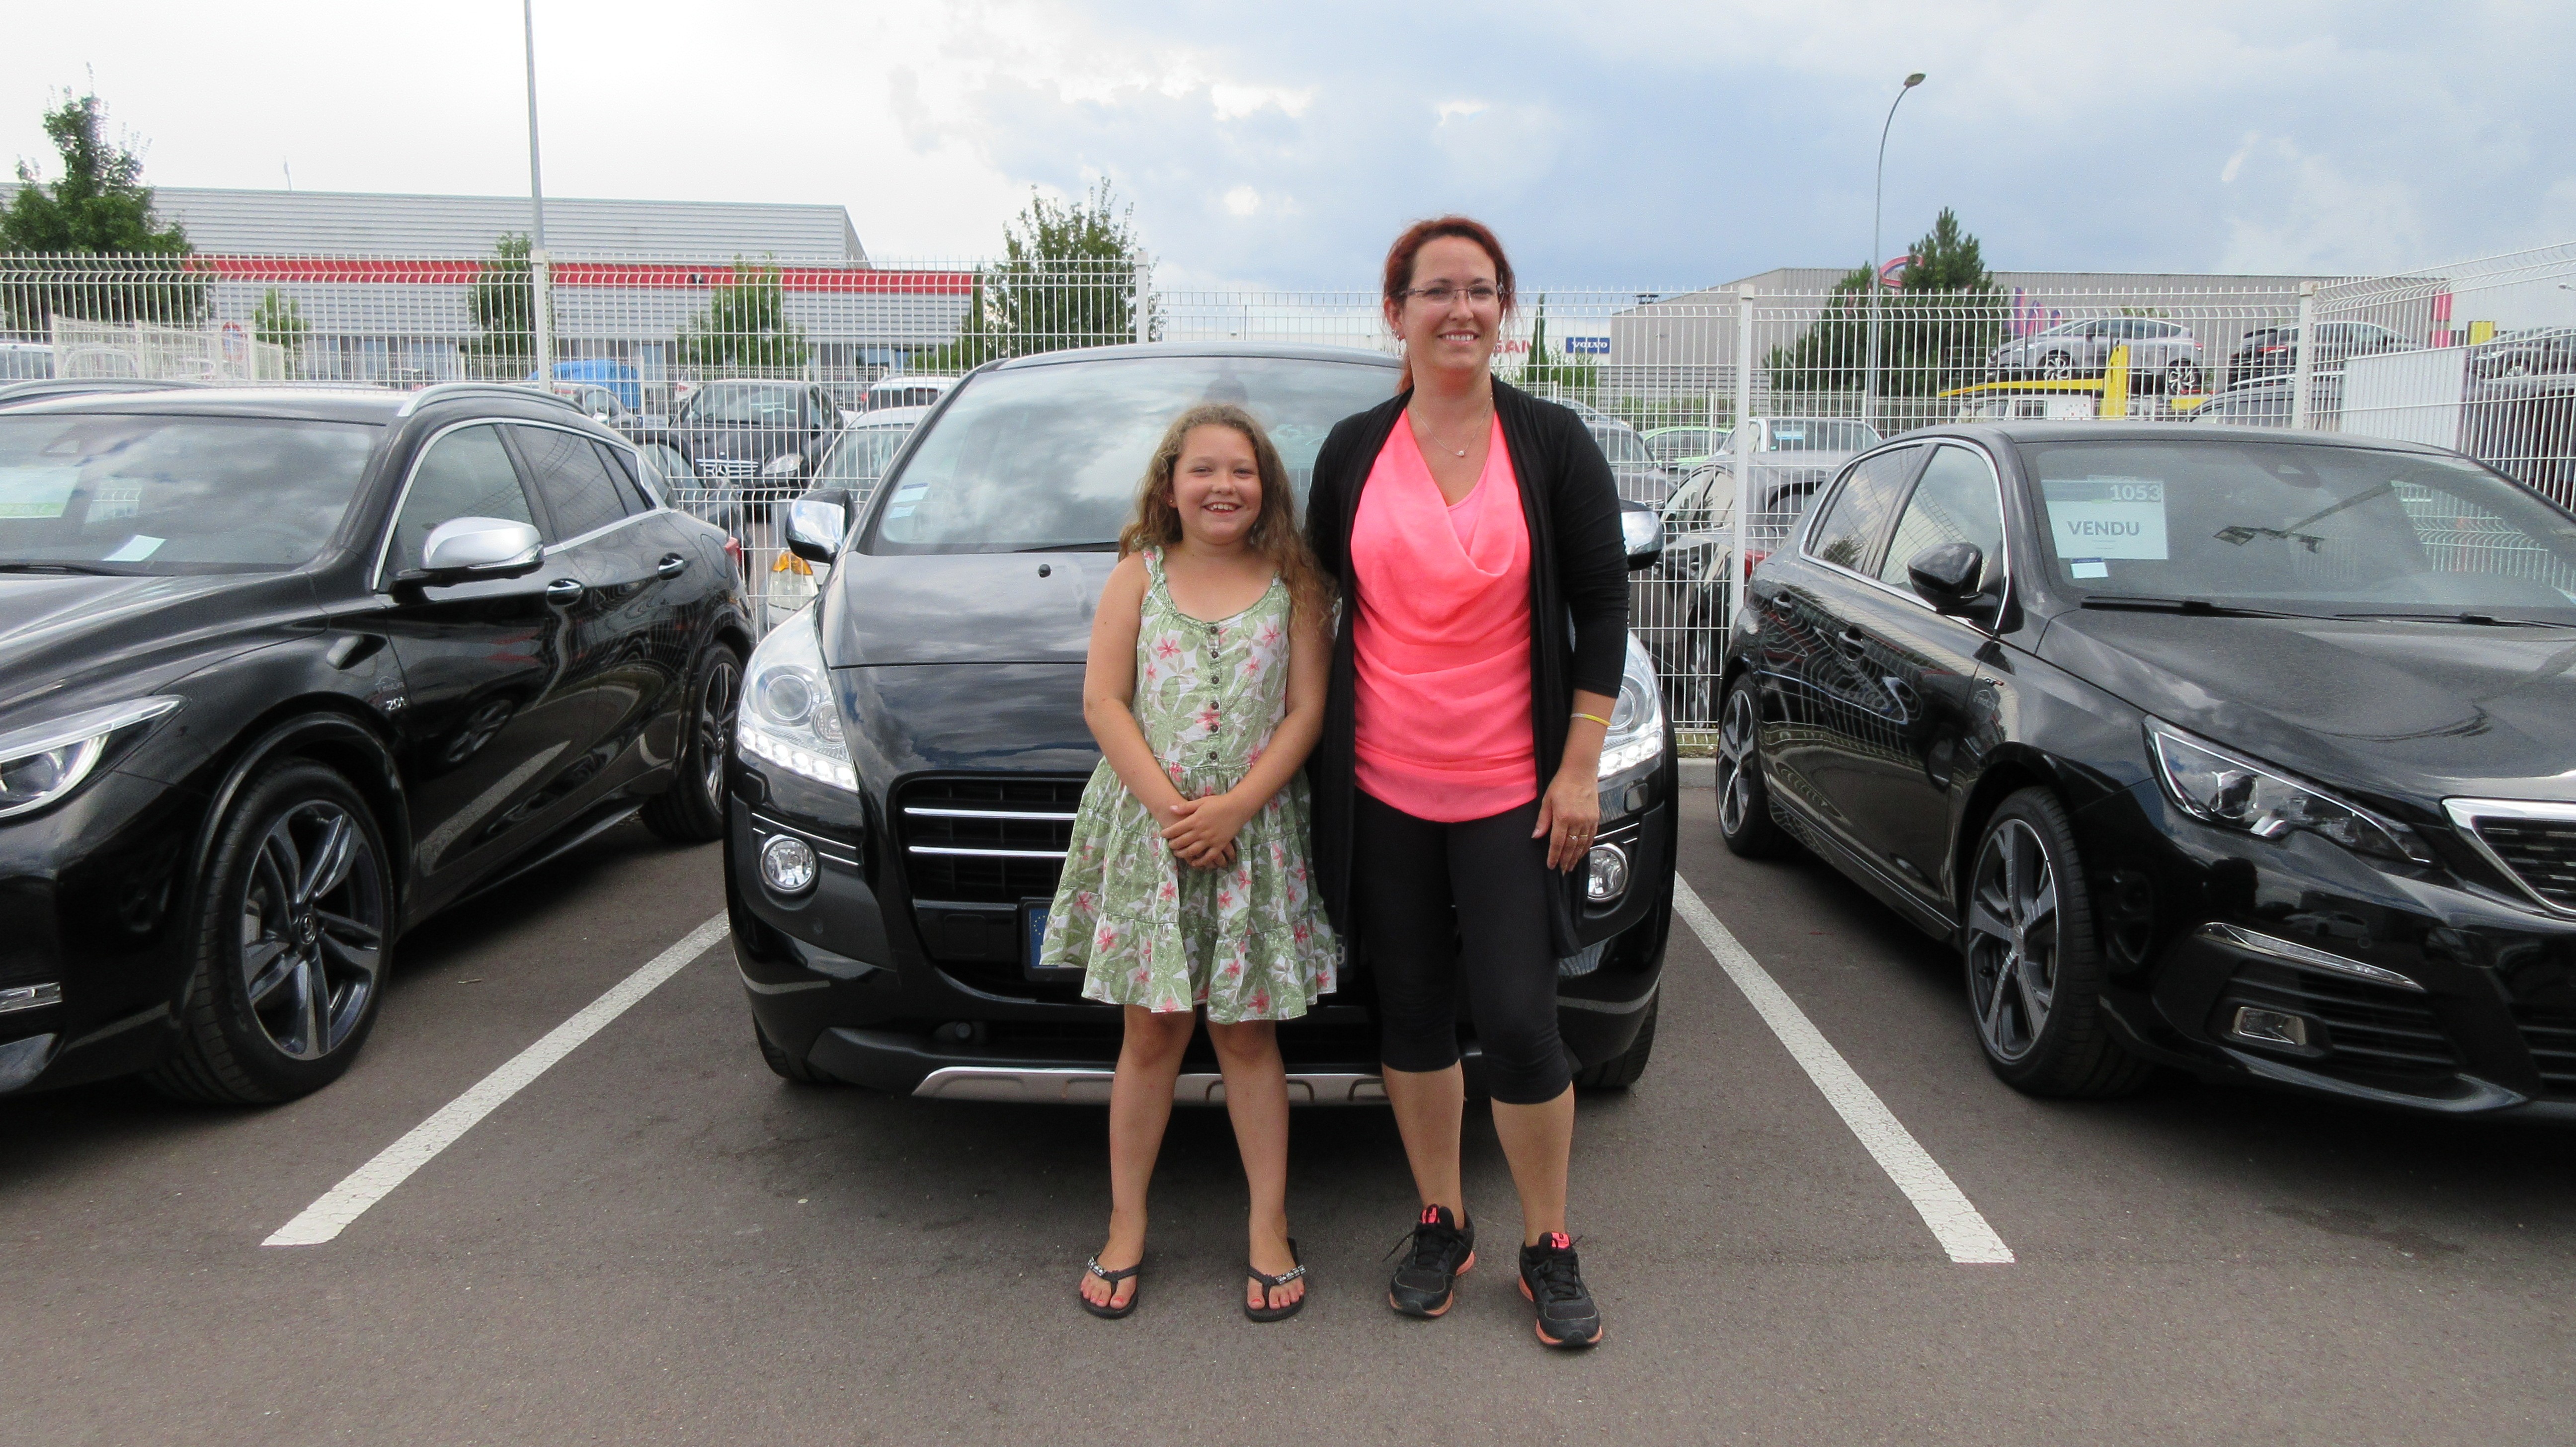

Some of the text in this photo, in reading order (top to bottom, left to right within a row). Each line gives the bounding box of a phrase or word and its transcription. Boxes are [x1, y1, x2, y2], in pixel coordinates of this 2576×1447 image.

[1493, 340, 1532, 353] SAN
[2110, 484, 2162, 501] 1053
[2067, 521, 2140, 536] VENDU
